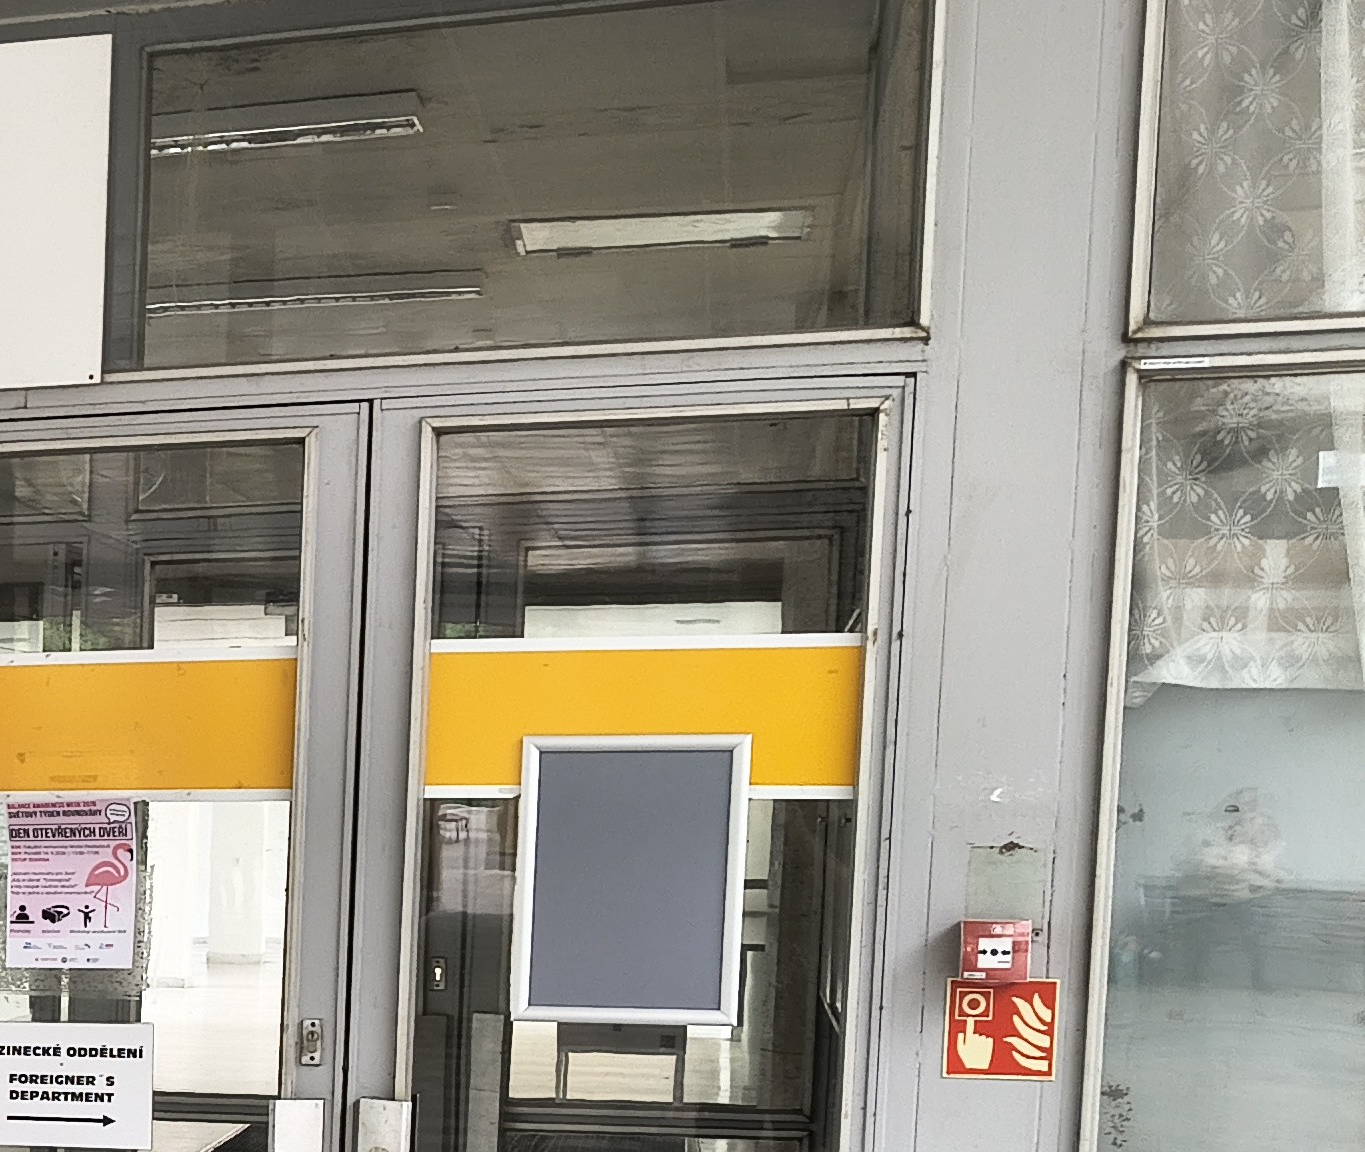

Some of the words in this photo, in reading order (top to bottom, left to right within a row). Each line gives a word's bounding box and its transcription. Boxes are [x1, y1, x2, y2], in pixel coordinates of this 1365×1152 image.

[10, 827, 30, 839] DEN
[32, 824, 96, 839] OTEVŘENÝCH
[98, 824, 128, 838] DVEŘÍ
[66, 1045, 144, 1059] ODDĚLENÍ
[9, 1089, 115, 1103] DEPARTMENT
